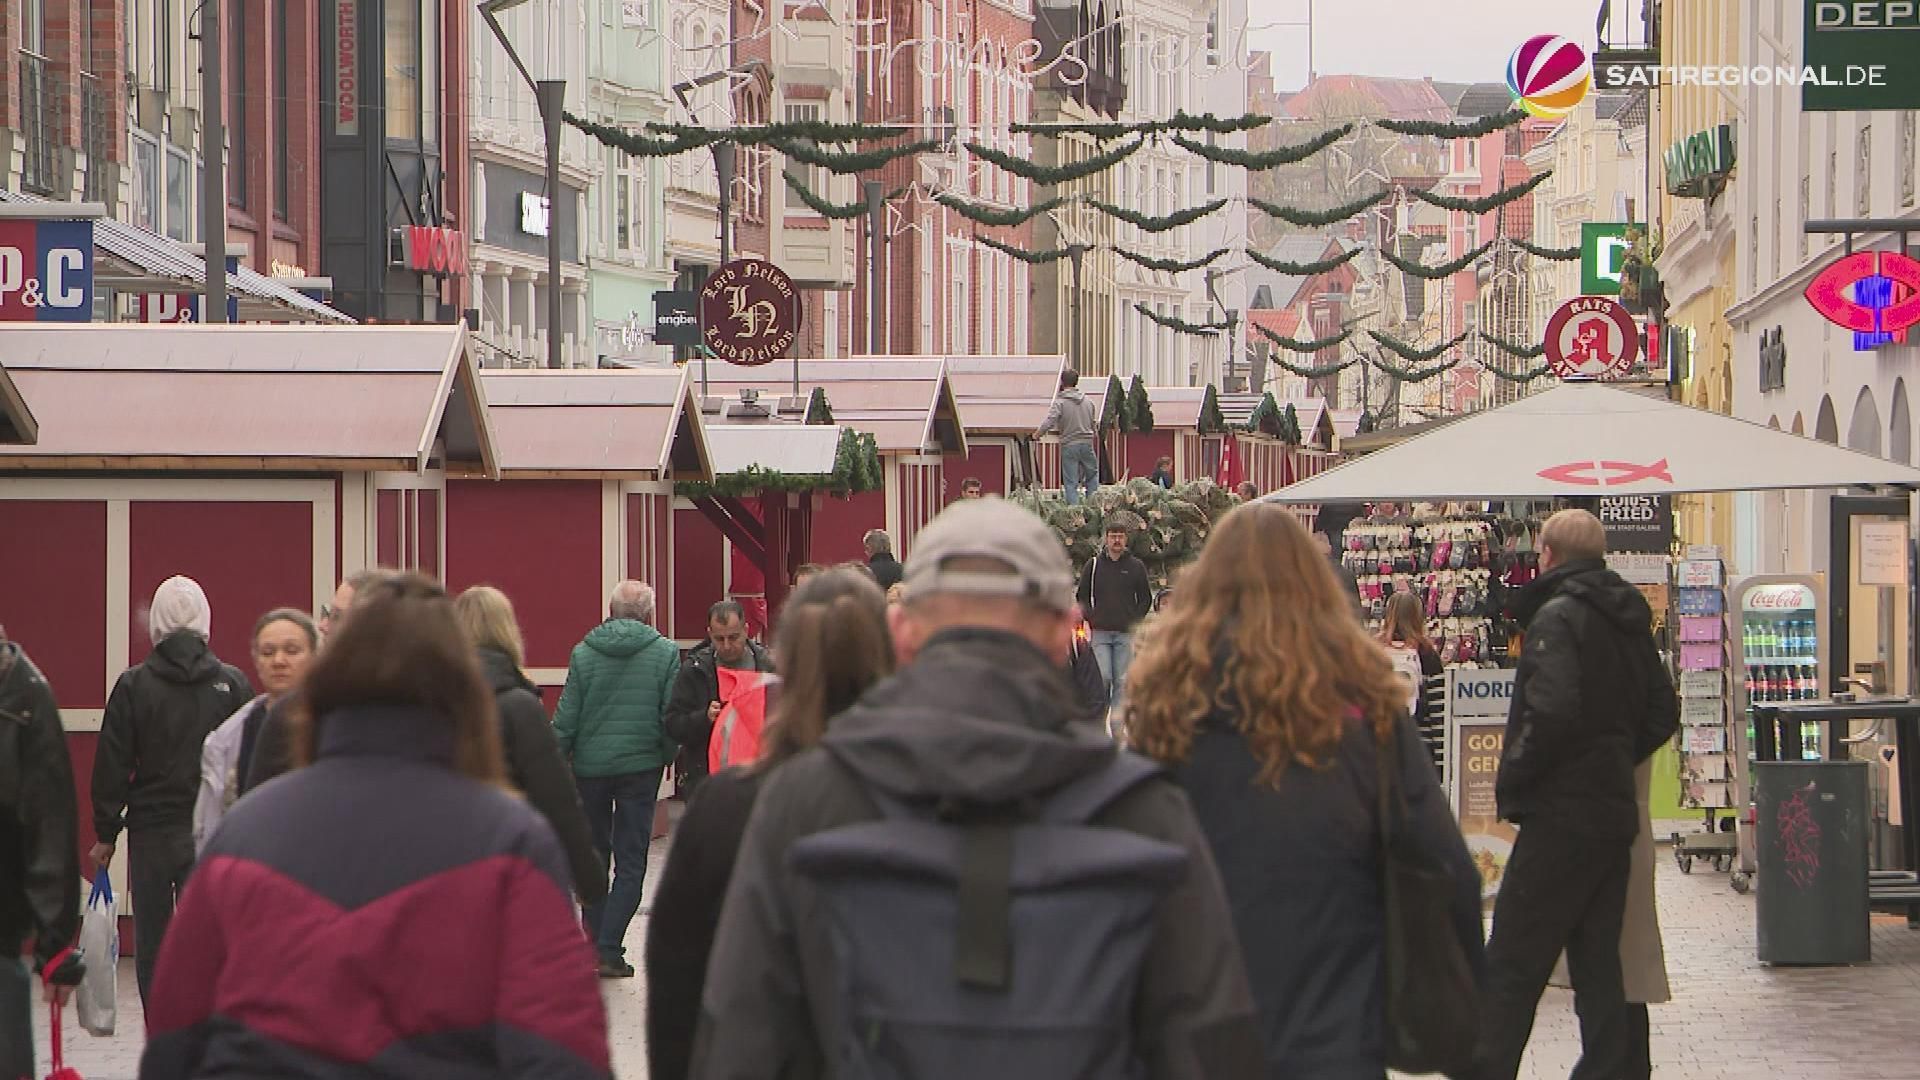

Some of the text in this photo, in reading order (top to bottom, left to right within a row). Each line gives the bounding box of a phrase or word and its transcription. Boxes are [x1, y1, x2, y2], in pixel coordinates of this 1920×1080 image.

[1815, 2, 1920, 26] DEP
[338, 2, 354, 124] WOOLWORTH
[0, 246, 84, 308] P&C
[743, 263, 793, 298] Nelson
[1570, 300, 1612, 314] RATS
[1600, 507, 1653, 521] FRIED
